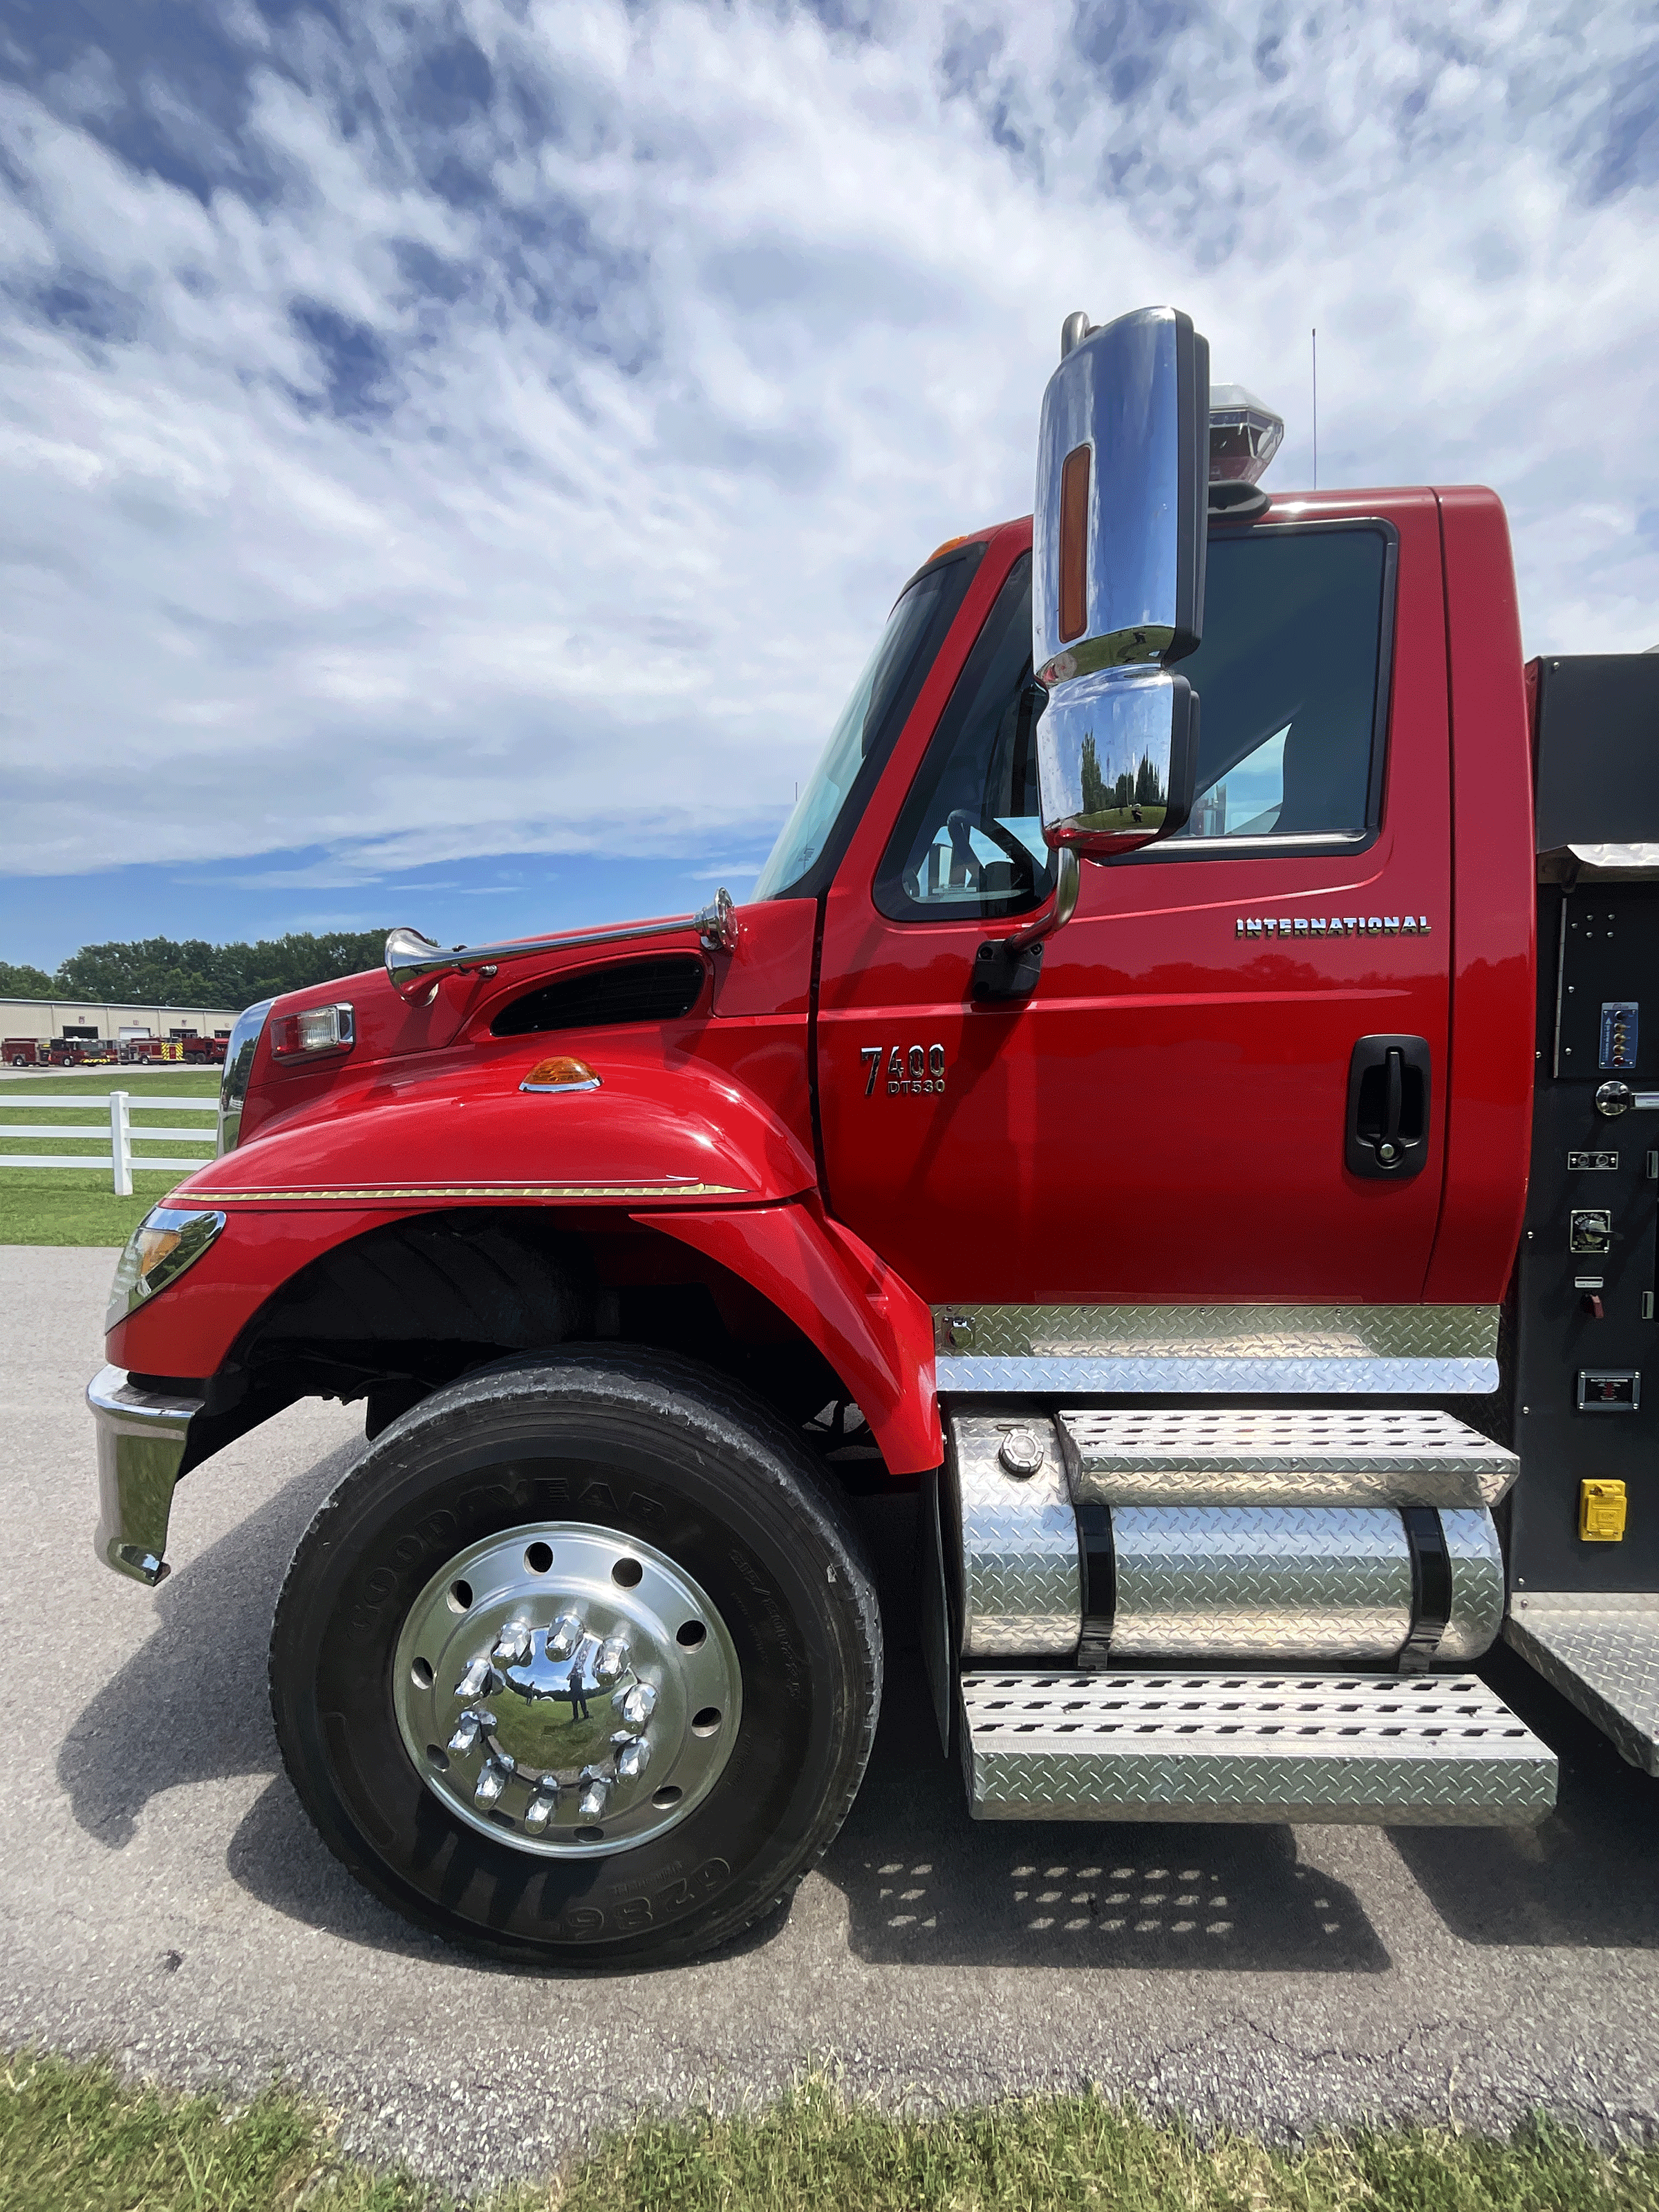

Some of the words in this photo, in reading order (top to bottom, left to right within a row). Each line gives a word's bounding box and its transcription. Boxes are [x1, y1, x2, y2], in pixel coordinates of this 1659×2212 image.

[1236, 916, 1432, 937] INTERNATIONAL
[861, 1044, 945, 1095] 7400
[888, 1078, 946, 1094] DT530
[347, 1477, 669, 1640] GOODYEAR
[565, 1857, 731, 1941] G286
